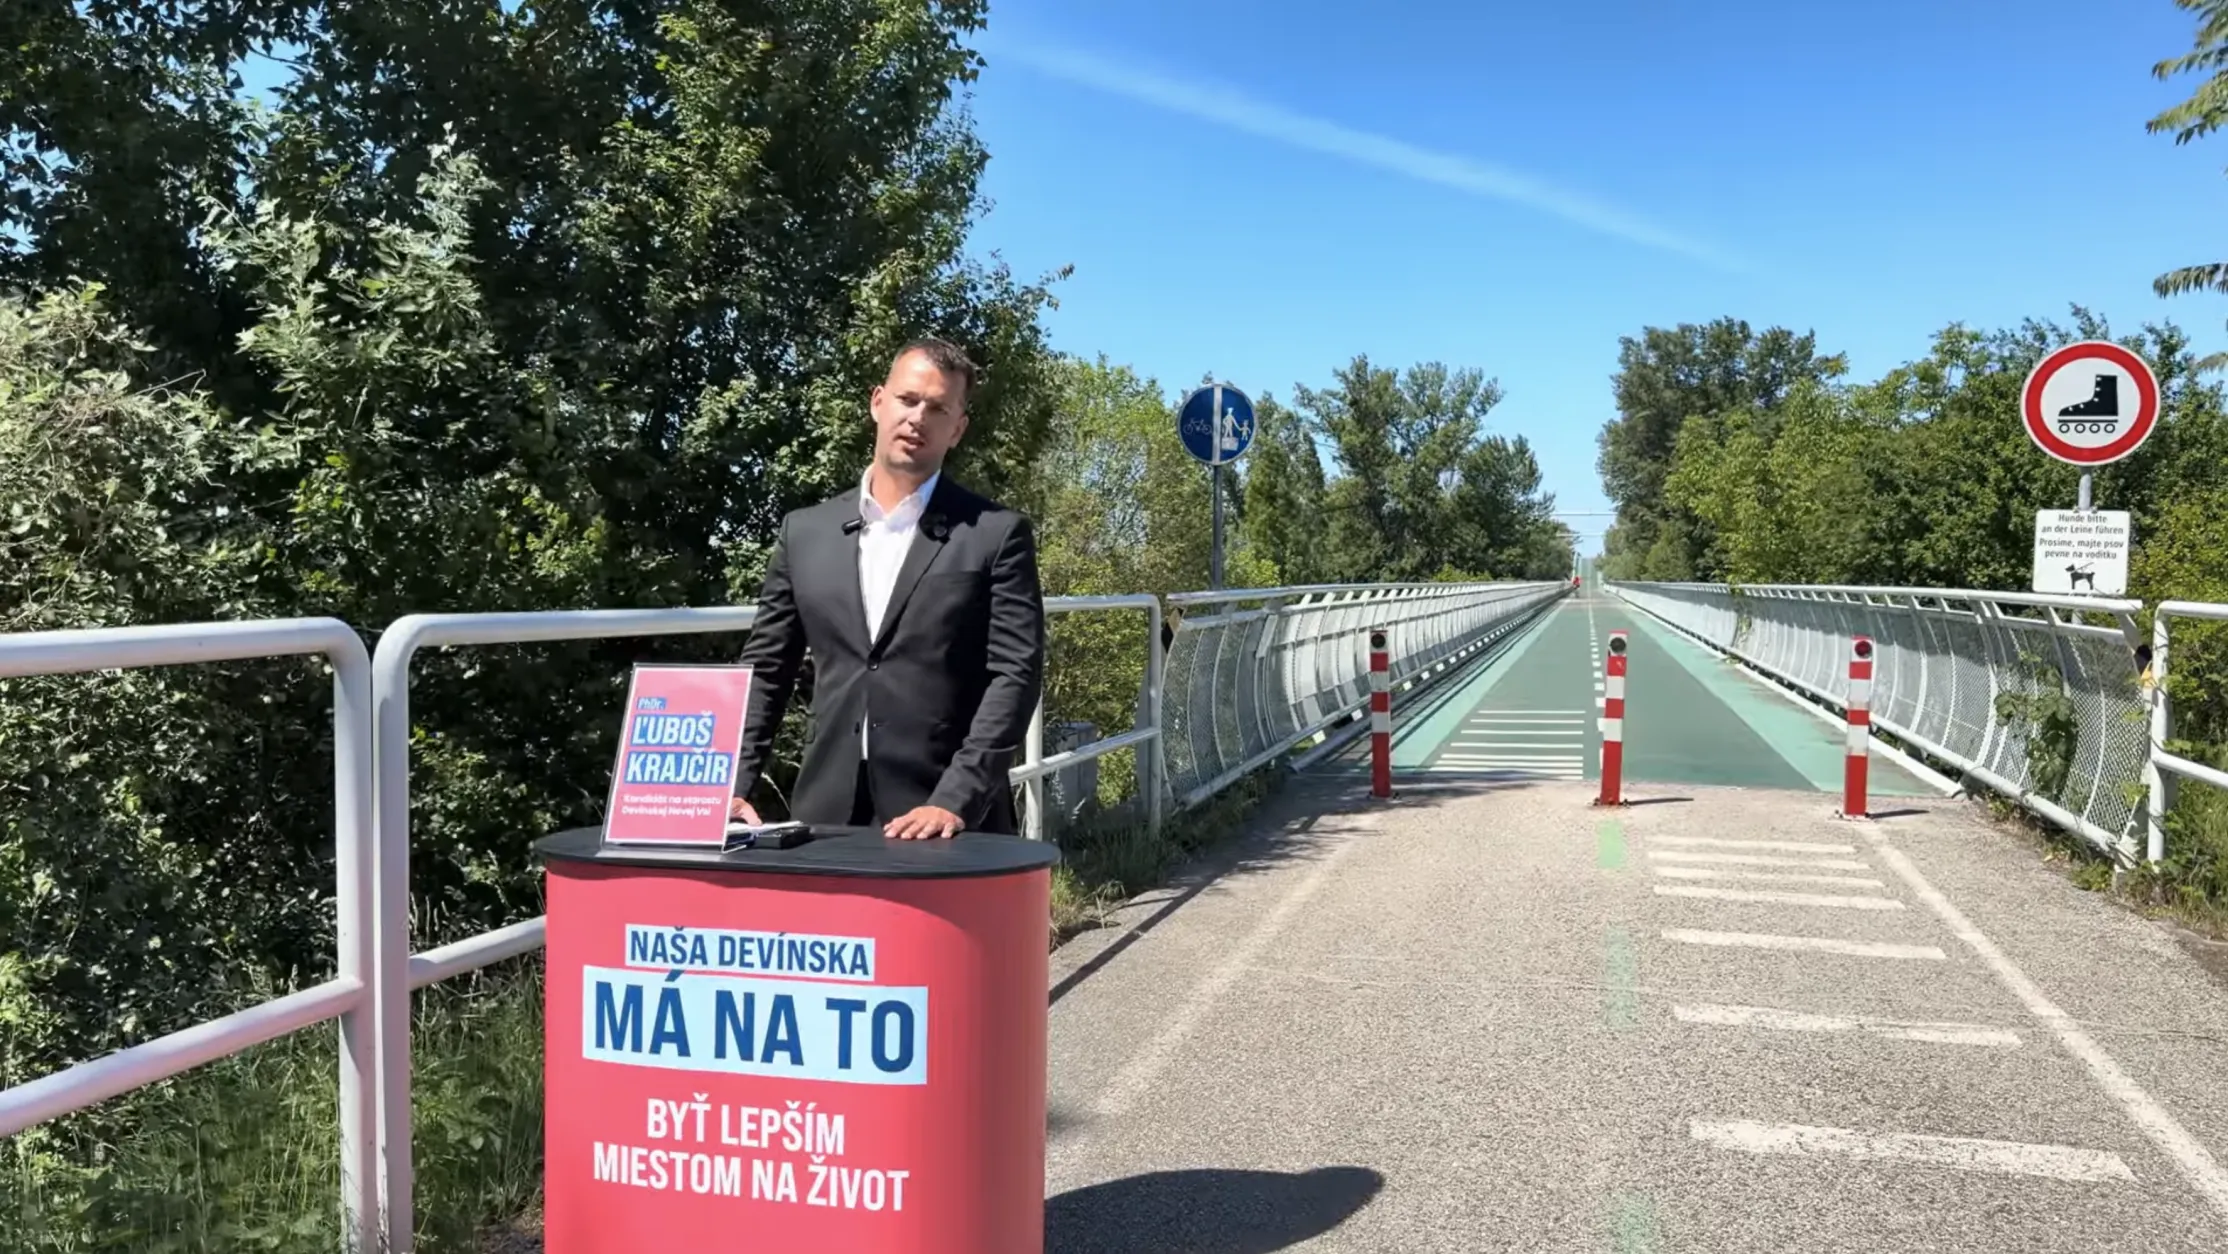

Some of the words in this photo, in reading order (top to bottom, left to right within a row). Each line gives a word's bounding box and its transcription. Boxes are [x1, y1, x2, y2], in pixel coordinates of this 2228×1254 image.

[2054, 525, 2068, 533] der
[2070, 525, 2093, 533] Leine
[2095, 525, 2124, 535] führen
[2058, 514, 2085, 522] Hunde
[2087, 515, 2107, 523] bitte
[2045, 550, 2070, 558] pevne
[2077, 539, 2102, 549] majte
[2103, 541, 2124, 549] psov
[638, 698, 664, 710] PhDr.
[631, 710, 714, 746] ĽUBOŠ
[626, 747, 729, 784] KRAJČÍR
[630, 926, 708, 966] NAŠA
[718, 932, 870, 976] DEVÍNSKA
[595, 970, 691, 1058] MÁ
[714, 989, 804, 1067] NA
[826, 997, 914, 1073] TO
[647, 1093, 711, 1143] BYŤ
[721, 1100, 845, 1155] LEPŠÍM
[593, 1142, 741, 1197] MIESTOM
[752, 1160, 797, 1203] NA
[807, 1155, 910, 1211] ŽIVOT
